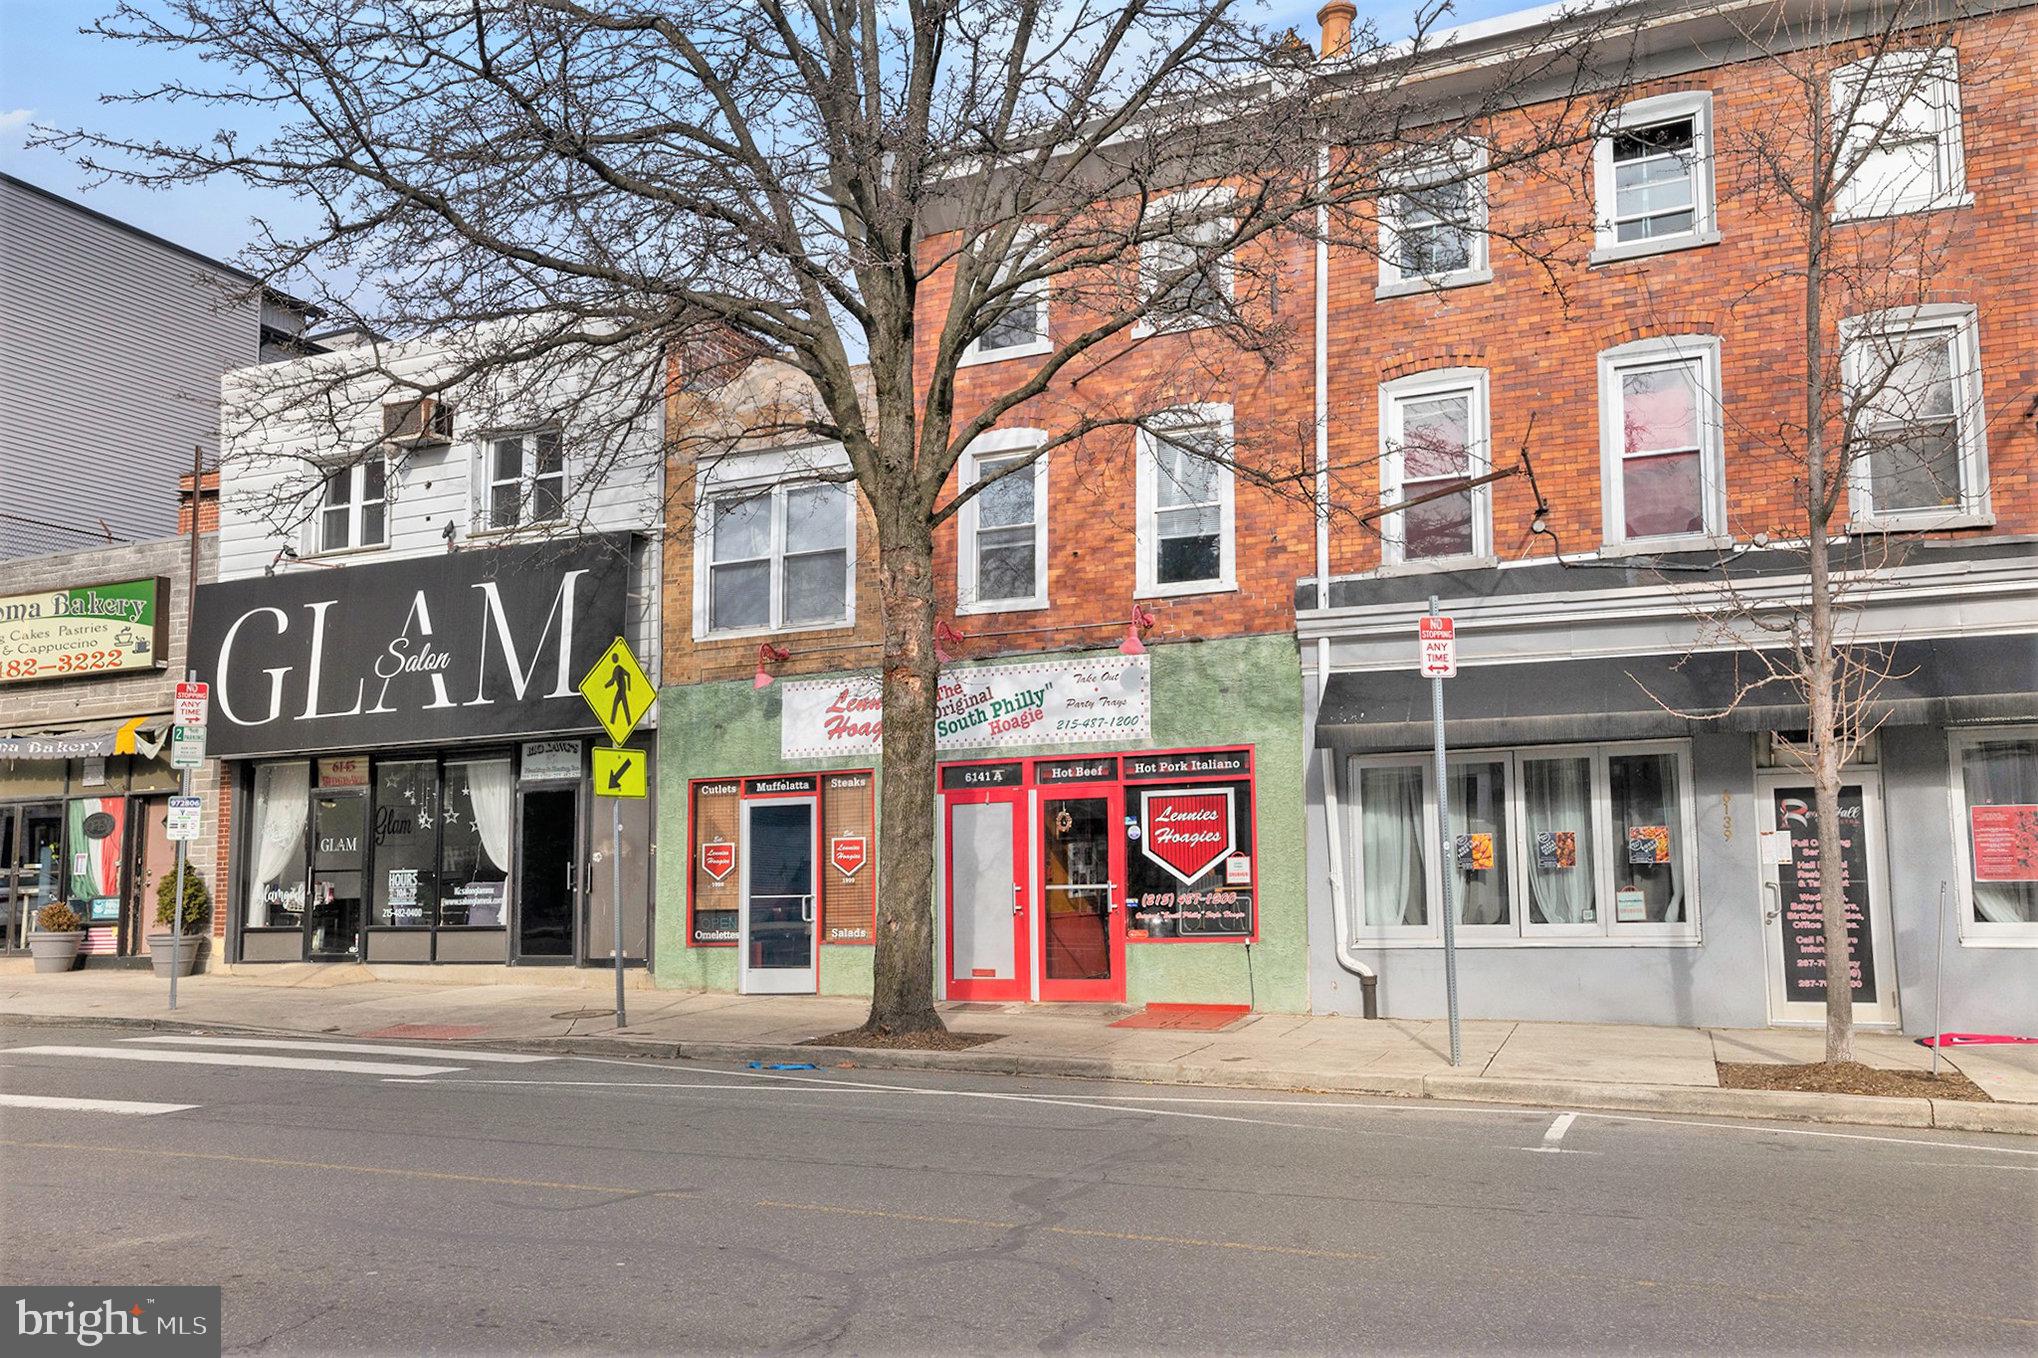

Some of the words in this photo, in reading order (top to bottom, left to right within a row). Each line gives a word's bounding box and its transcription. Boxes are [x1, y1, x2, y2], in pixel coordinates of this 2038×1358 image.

[51, 591, 147, 623] Bakery
[1430, 618, 1443, 630] NO
[10, 628, 50, 642] Cakes
[59, 623, 108, 637] Pastries
[18, 639, 98, 655] Cappuccino
[216, 569, 590, 727] GLAM
[1427, 643, 1447, 651] ANY
[374, 636, 450, 679] Salon
[1427, 654, 1449, 662] TIME
[1073, 673, 1097, 684] Take
[1101, 671, 1119, 682] Out
[186, 684, 198, 692] NO
[936, 683, 963, 702] The
[825, 688, 882, 713] Lenn
[1066, 698, 1095, 709] Party
[1099, 696, 1127, 708] Trays
[824, 715, 882, 743] Hoag
[937, 708, 988, 737] South
[988, 708, 1043, 736] Hoagie
[1057, 715, 1138, 730] 215-487-1200
[175, 728, 183, 740] 2
[27, 741, 103, 753] Bakery
[332, 760, 355, 772] 6145
[1052, 767, 1073, 778] Hot
[1076, 766, 1103, 777] Beef
[1134, 762, 1156, 774] Hot
[1159, 762, 1188, 773] Pork
[1191, 760, 1240, 771] Italiano
[831, 777, 866, 788] Steaks
[965, 772, 990, 782] 6141
[701, 785, 737, 795] Cutlets
[756, 780, 810, 792] Muffelatta
[1154, 806, 1219, 822] Lennies
[375, 806, 413, 846] Glam
[1154, 827, 1221, 848] Hoagies
[321, 838, 357, 852] GLAM
[389, 873, 418, 887] HOURS
[1141, 892, 1175, 908] (215)
[1177, 891, 1237, 905] 487-1200
[382, 908, 422, 918] 215-482-0400
[701, 916, 737, 930] OPEN
[695, 930, 740, 940] Omelettes
[831, 928, 866, 938] Salads
